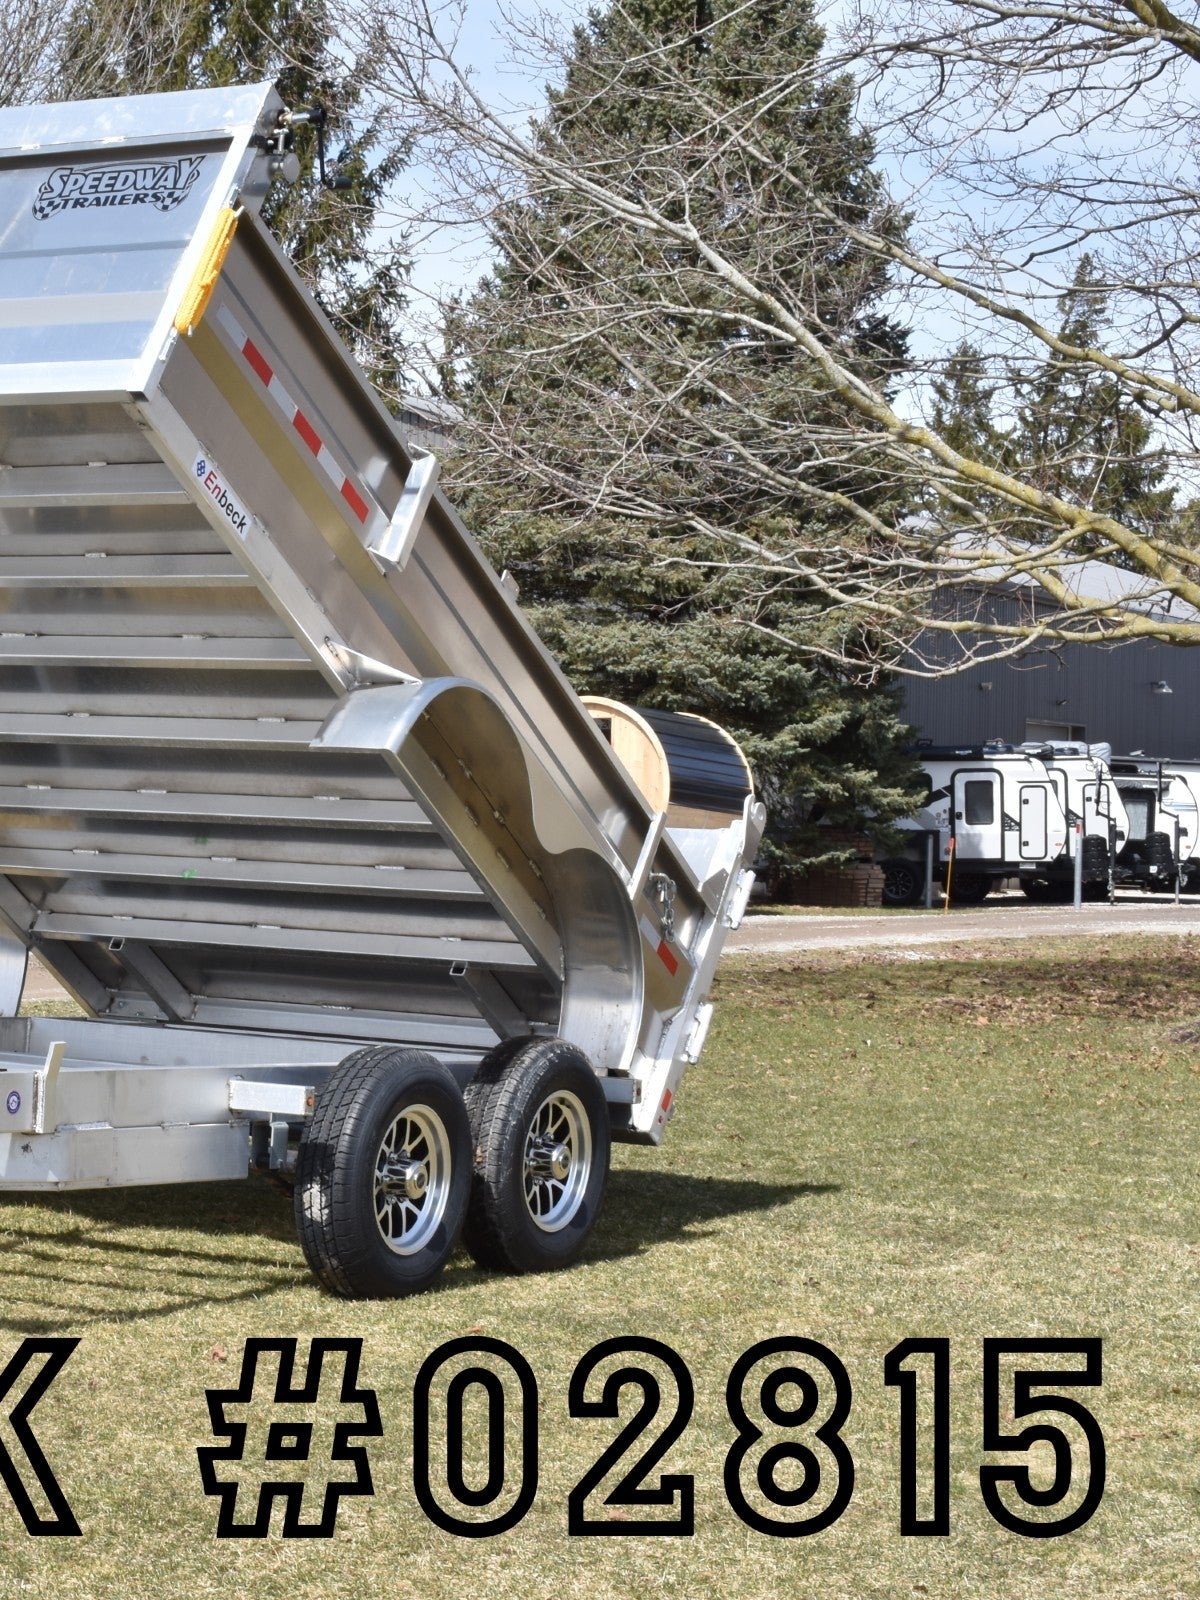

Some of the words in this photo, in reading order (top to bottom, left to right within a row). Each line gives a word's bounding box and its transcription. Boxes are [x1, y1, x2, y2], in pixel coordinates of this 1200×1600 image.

[39, 155, 206, 201] SPEEDWAY
[61, 192, 163, 210] TRAILERS
[203, 470, 247, 534] Enbeck
